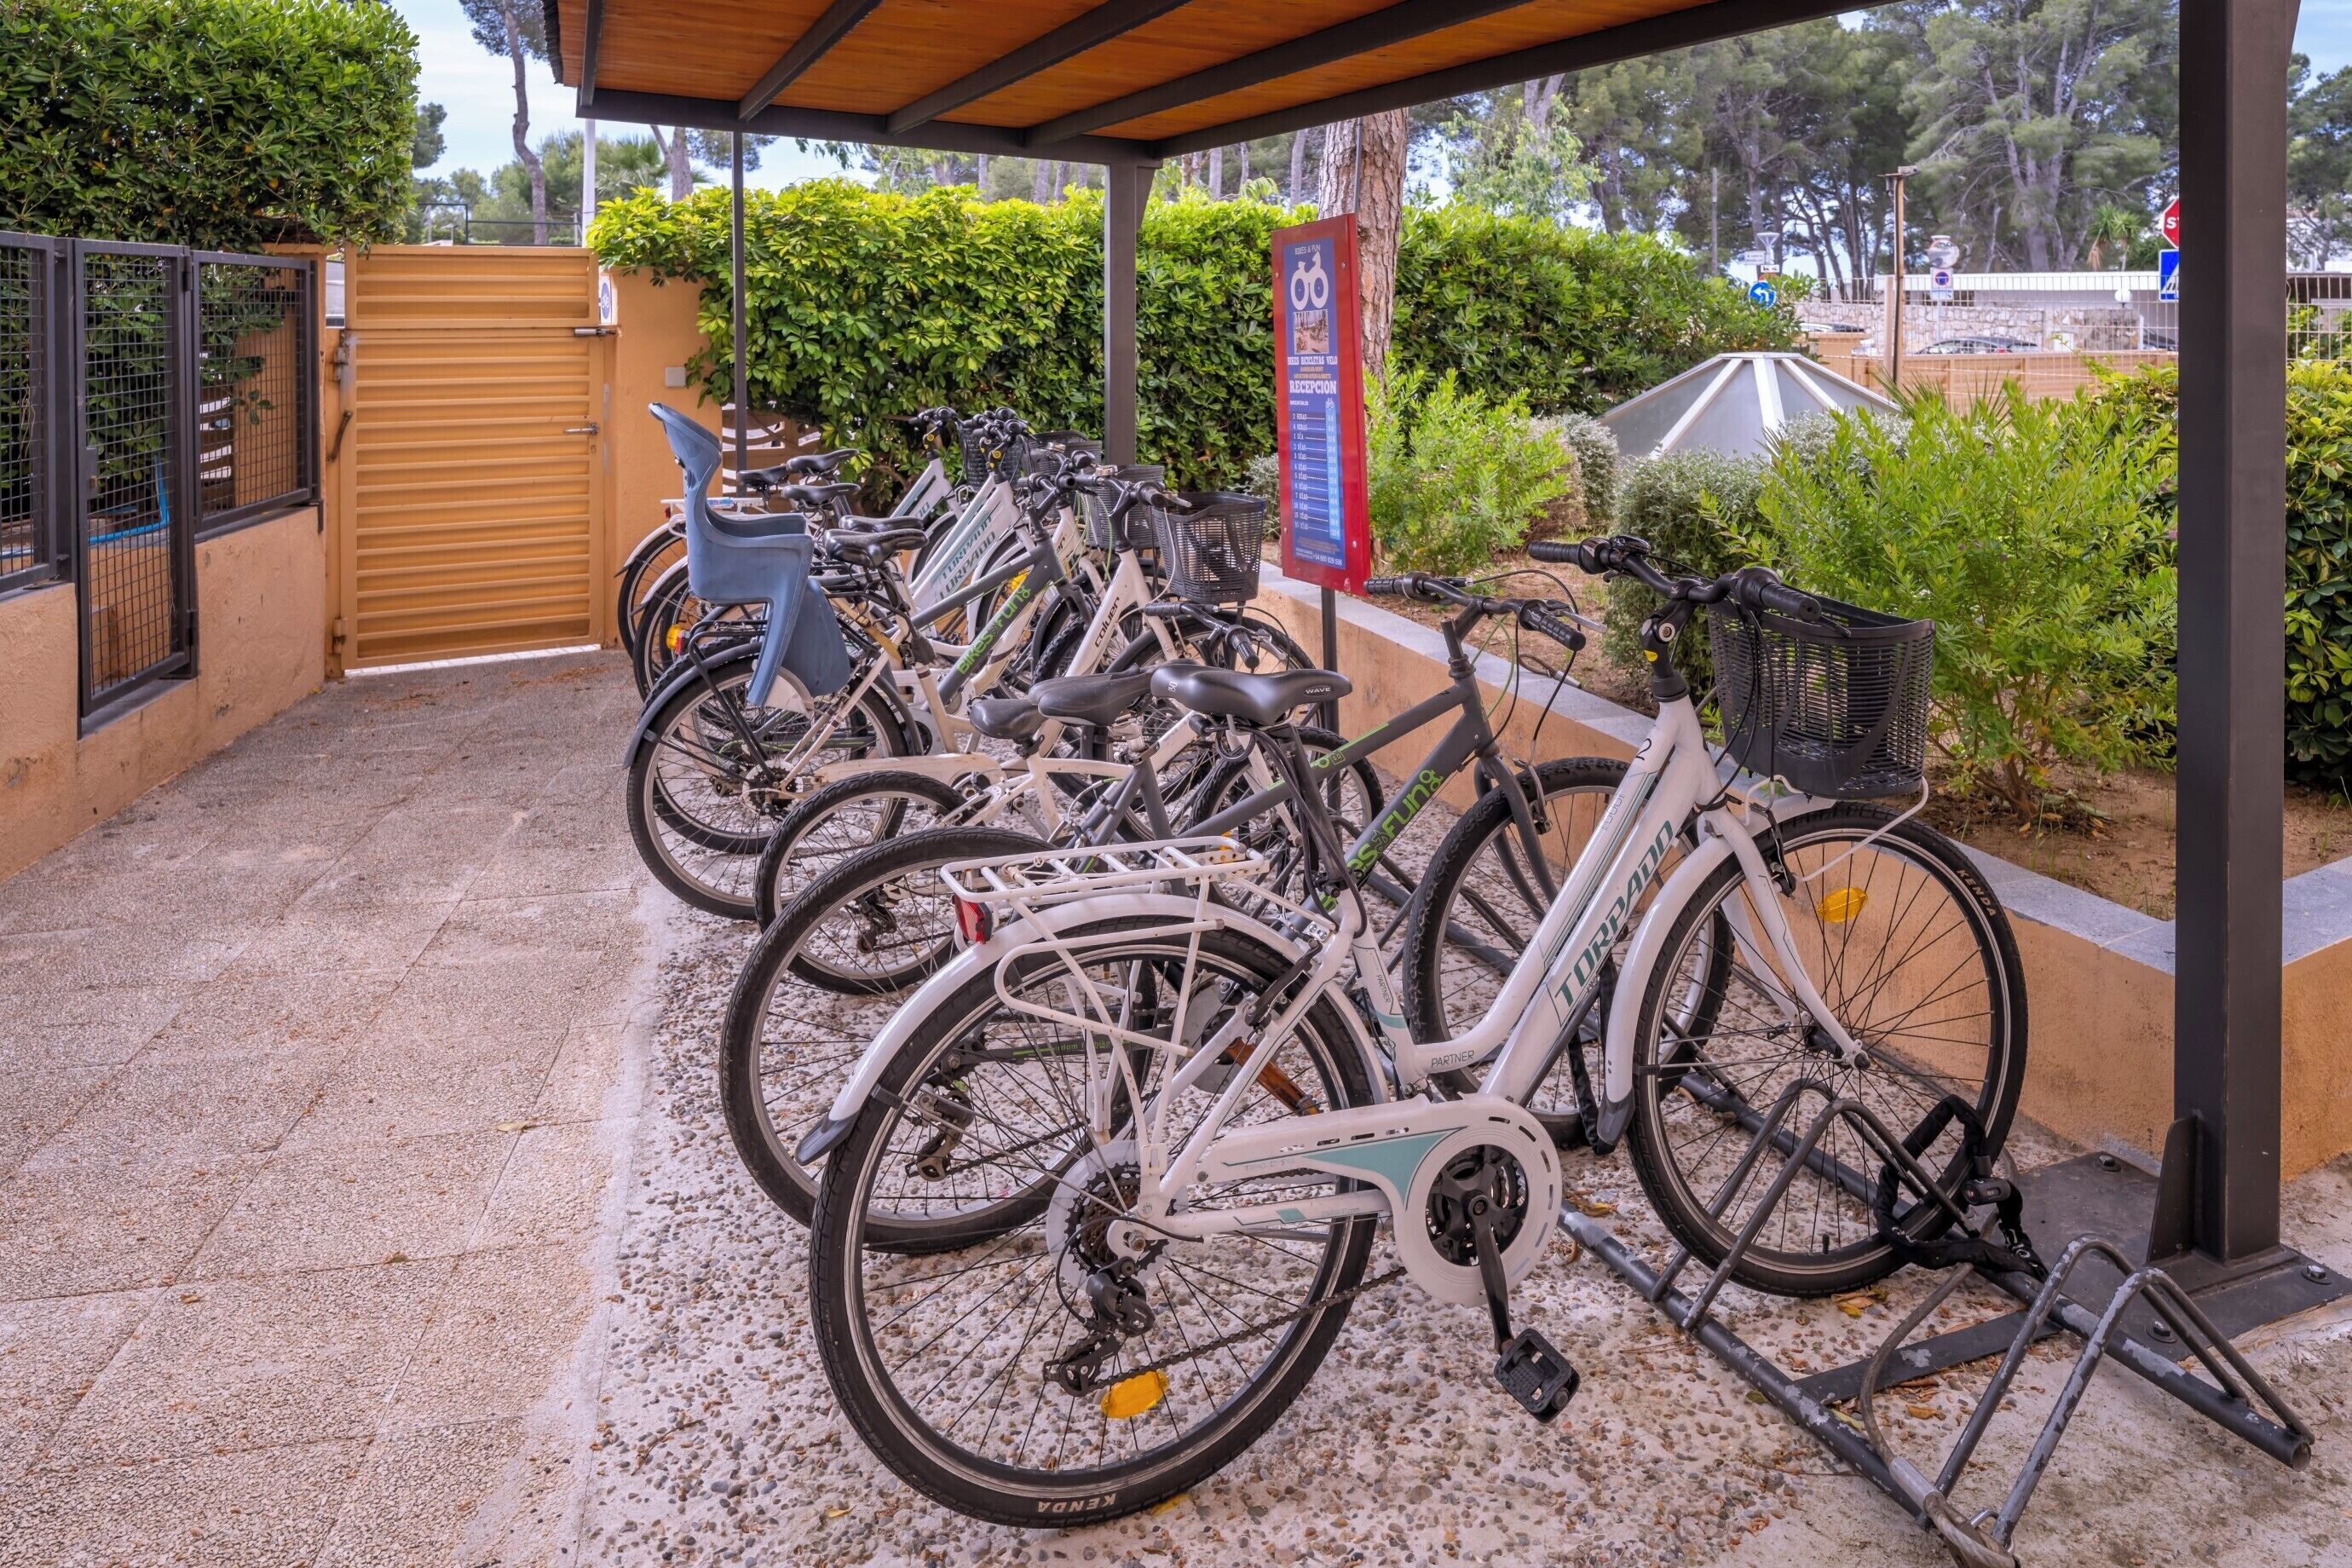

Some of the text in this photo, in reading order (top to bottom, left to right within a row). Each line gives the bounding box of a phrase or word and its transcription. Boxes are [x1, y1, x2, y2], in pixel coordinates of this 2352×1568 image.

[1325, 355, 1338, 366] VELO
[1288, 380, 1337, 395] RECEPCION
[1305, 686, 1332, 695] WAVE
[1634, 738, 1652, 761] 2
[1957, 869, 1997, 916] KENDA
[1554, 820, 1674, 1007] TORPADO
[1375, 974, 1392, 1004] PARTNER
[1431, 1050, 1475, 1068] PARTNER
[1071, 1248, 1091, 1271] SHIMANO
[1037, 1493, 1116, 1513] KENDA
